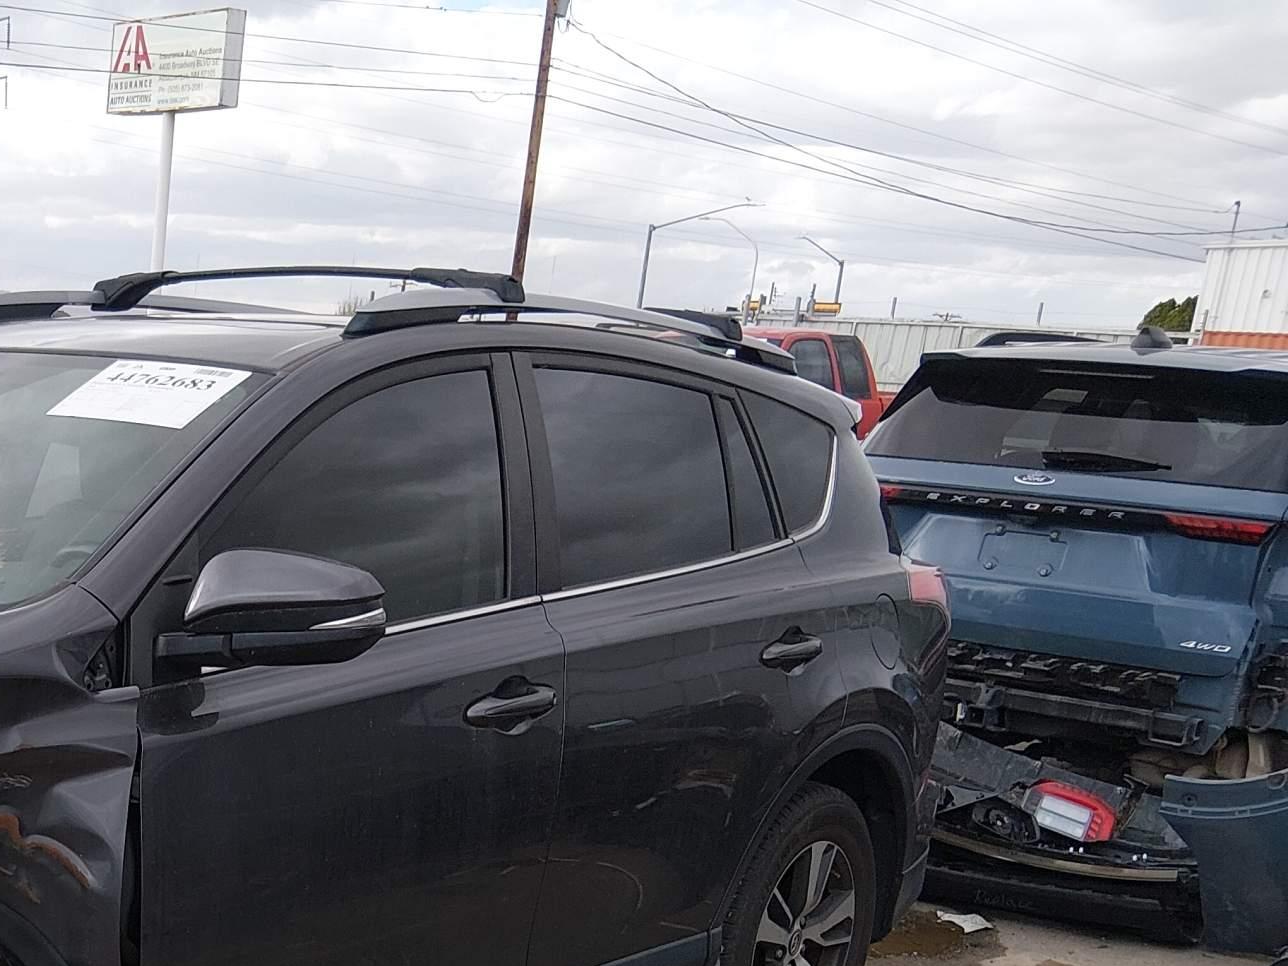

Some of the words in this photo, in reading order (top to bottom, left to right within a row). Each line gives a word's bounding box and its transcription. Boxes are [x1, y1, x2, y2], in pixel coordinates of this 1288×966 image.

[111, 79, 153, 91] INSURANCE
[110, 95, 125, 105] AUTO
[125, 93, 152, 104] AUCTIONS
[106, 371, 216, 391] 44762683
[926, 491, 1127, 519] EXPLORER
[1179, 640, 1232, 653] 4WD
